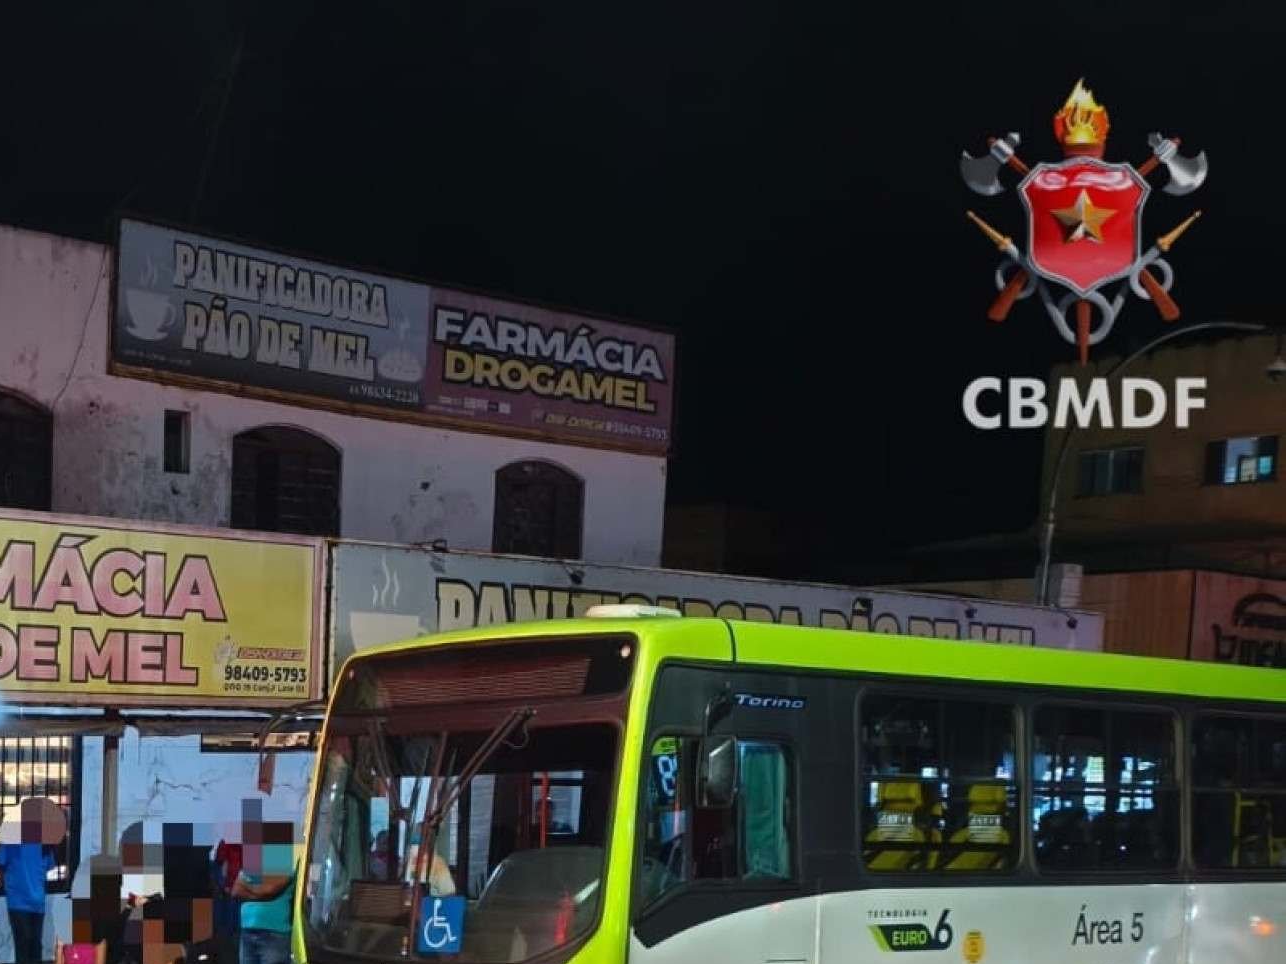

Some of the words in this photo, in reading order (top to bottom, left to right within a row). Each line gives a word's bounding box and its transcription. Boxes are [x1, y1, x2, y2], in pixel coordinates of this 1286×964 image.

[174, 240, 389, 328] PANIFICADORA
[181, 296, 252, 359] PÃO
[256, 316, 302, 370] DE
[308, 325, 376, 383] MEL
[433, 305, 667, 383] FARMÁCIA
[442, 344, 656, 413] DROGAMEL
[70, 628, 198, 686] MEL
[225, 664, 306, 682] 98409-5793
[735, 693, 805, 709] Torino
[868, 909, 928, 919] TECNOLOGIA
[891, 930, 927, 946] EURO
[935, 908, 953, 950] 6
[1072, 904, 1123, 945] Área
[1131, 912, 1144, 942] 5
